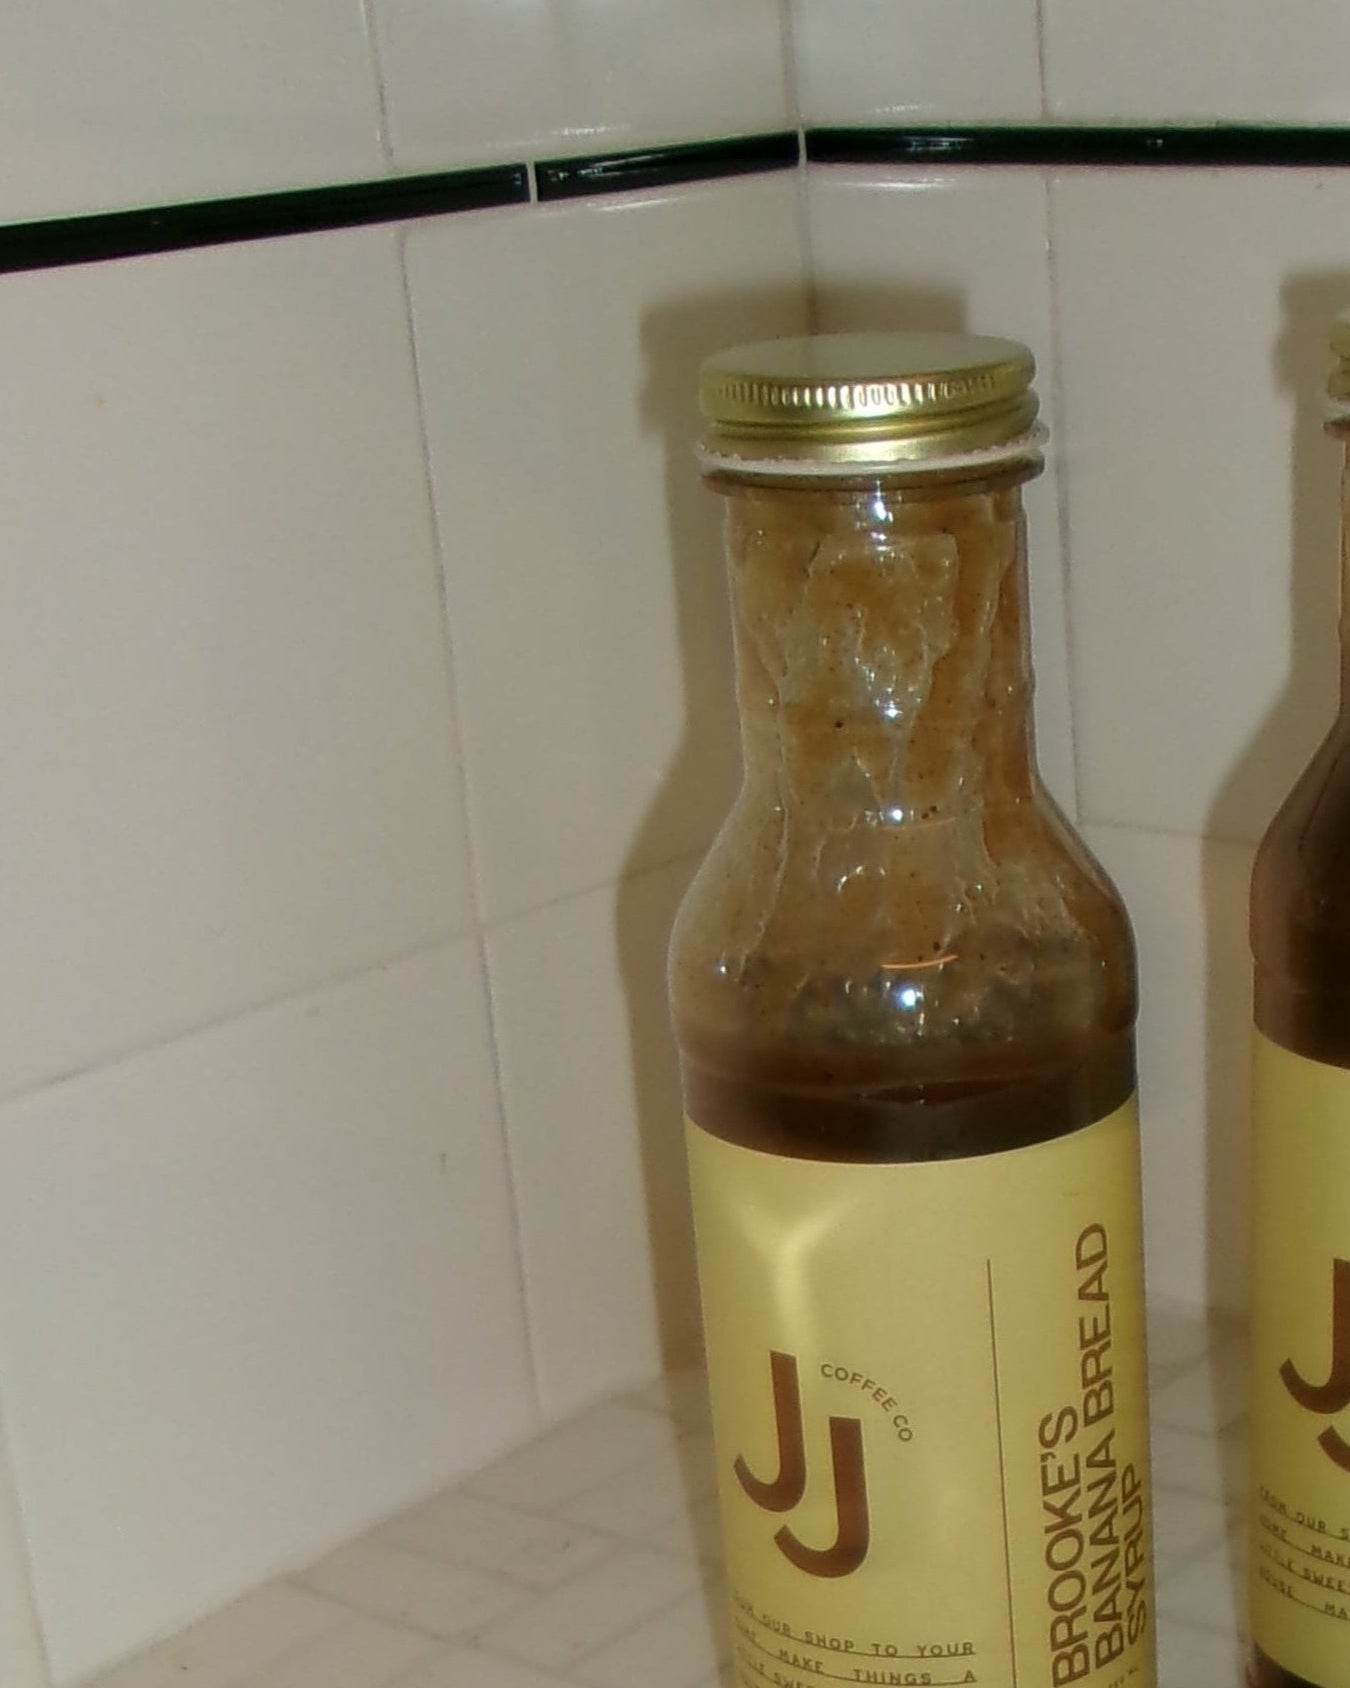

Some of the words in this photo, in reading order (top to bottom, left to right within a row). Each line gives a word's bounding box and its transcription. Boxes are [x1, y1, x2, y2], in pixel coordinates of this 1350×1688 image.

[1075, 1223, 1115, 1427] BREAD
[821, 1363, 898, 1412] COFFEE
[893, 1414, 913, 1442] CO
[1038, 1406, 1090, 1688] BROOKE'S
[1085, 1427, 1125, 1669] BANANA
[1120, 1463, 1147, 1645] SYRUP
[1296, 1512, 1327, 1535] OUR
[762, 1613, 791, 1637] OUR
[804, 1631, 855, 1652] SHOP
[872, 1643, 898, 1657] TO
[917, 1642, 975, 1656] YOUR
[779, 1649, 824, 1674] MAKE
[852, 1669, 932, 1686] THINGS
[964, 1670, 976, 1683] A
